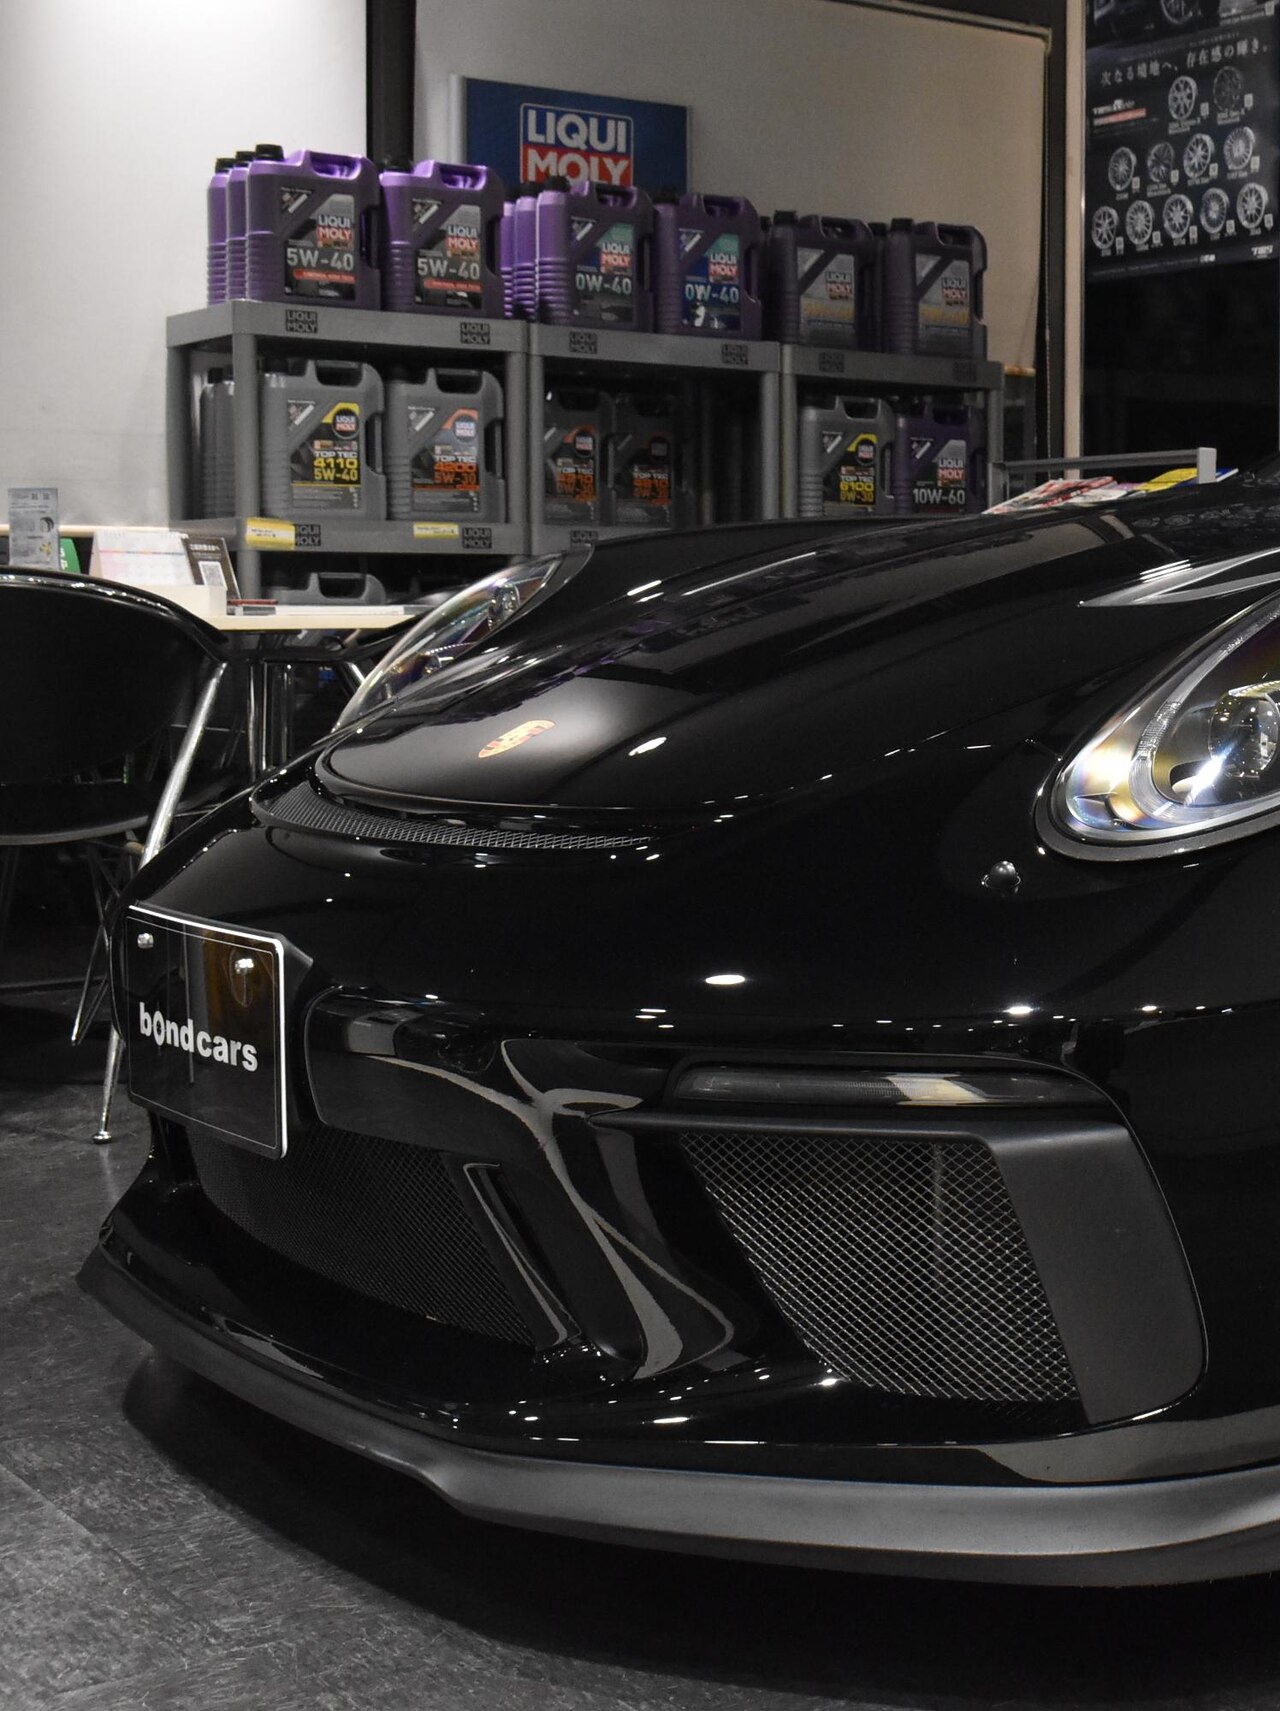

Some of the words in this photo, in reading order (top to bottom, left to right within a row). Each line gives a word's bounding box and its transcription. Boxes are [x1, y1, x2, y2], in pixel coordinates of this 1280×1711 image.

[527, 109, 626, 153] LIQUI
[527, 148, 629, 187] MOLY
[318, 215, 351, 228] LIQUI
[319, 227, 352, 240] MOLY
[447, 225, 477, 238] LIQUI
[447, 237, 478, 249] MOLY
[602, 242, 630, 255] LIQUI
[287, 247, 354, 271] 5W-40
[601, 253, 631, 266] MOLY
[710, 253, 737, 264] LIQUI
[417, 258, 480, 280] 5W-40
[710, 263, 738, 275] MOLY
[827, 271, 852, 282] LIQUI
[575, 273, 632, 295] 0W-40
[943, 277, 967, 288] LIQUI
[685, 284, 739, 304] 0W-40
[826, 283, 852, 294] MOLY
[942, 288, 968, 299] MOLY
[287, 310, 316, 321] LIQUI
[287, 322, 317, 333] MOLY
[461, 322, 489, 333] LIQUI
[461, 334, 490, 344] MOLY
[314, 458, 358, 468] 4110
[434, 463, 476, 472] 4200
[938, 459, 964, 468] LIQUI
[314, 468, 358, 481] 5W-40
[434, 472, 476, 485] 5W-30
[938, 468, 964, 479] MOLY
[839, 482, 874, 492] 6100
[913, 488, 965, 505] 10W-60
[464, 528, 491, 538] LIQUI
[464, 537, 491, 548] MOLY
